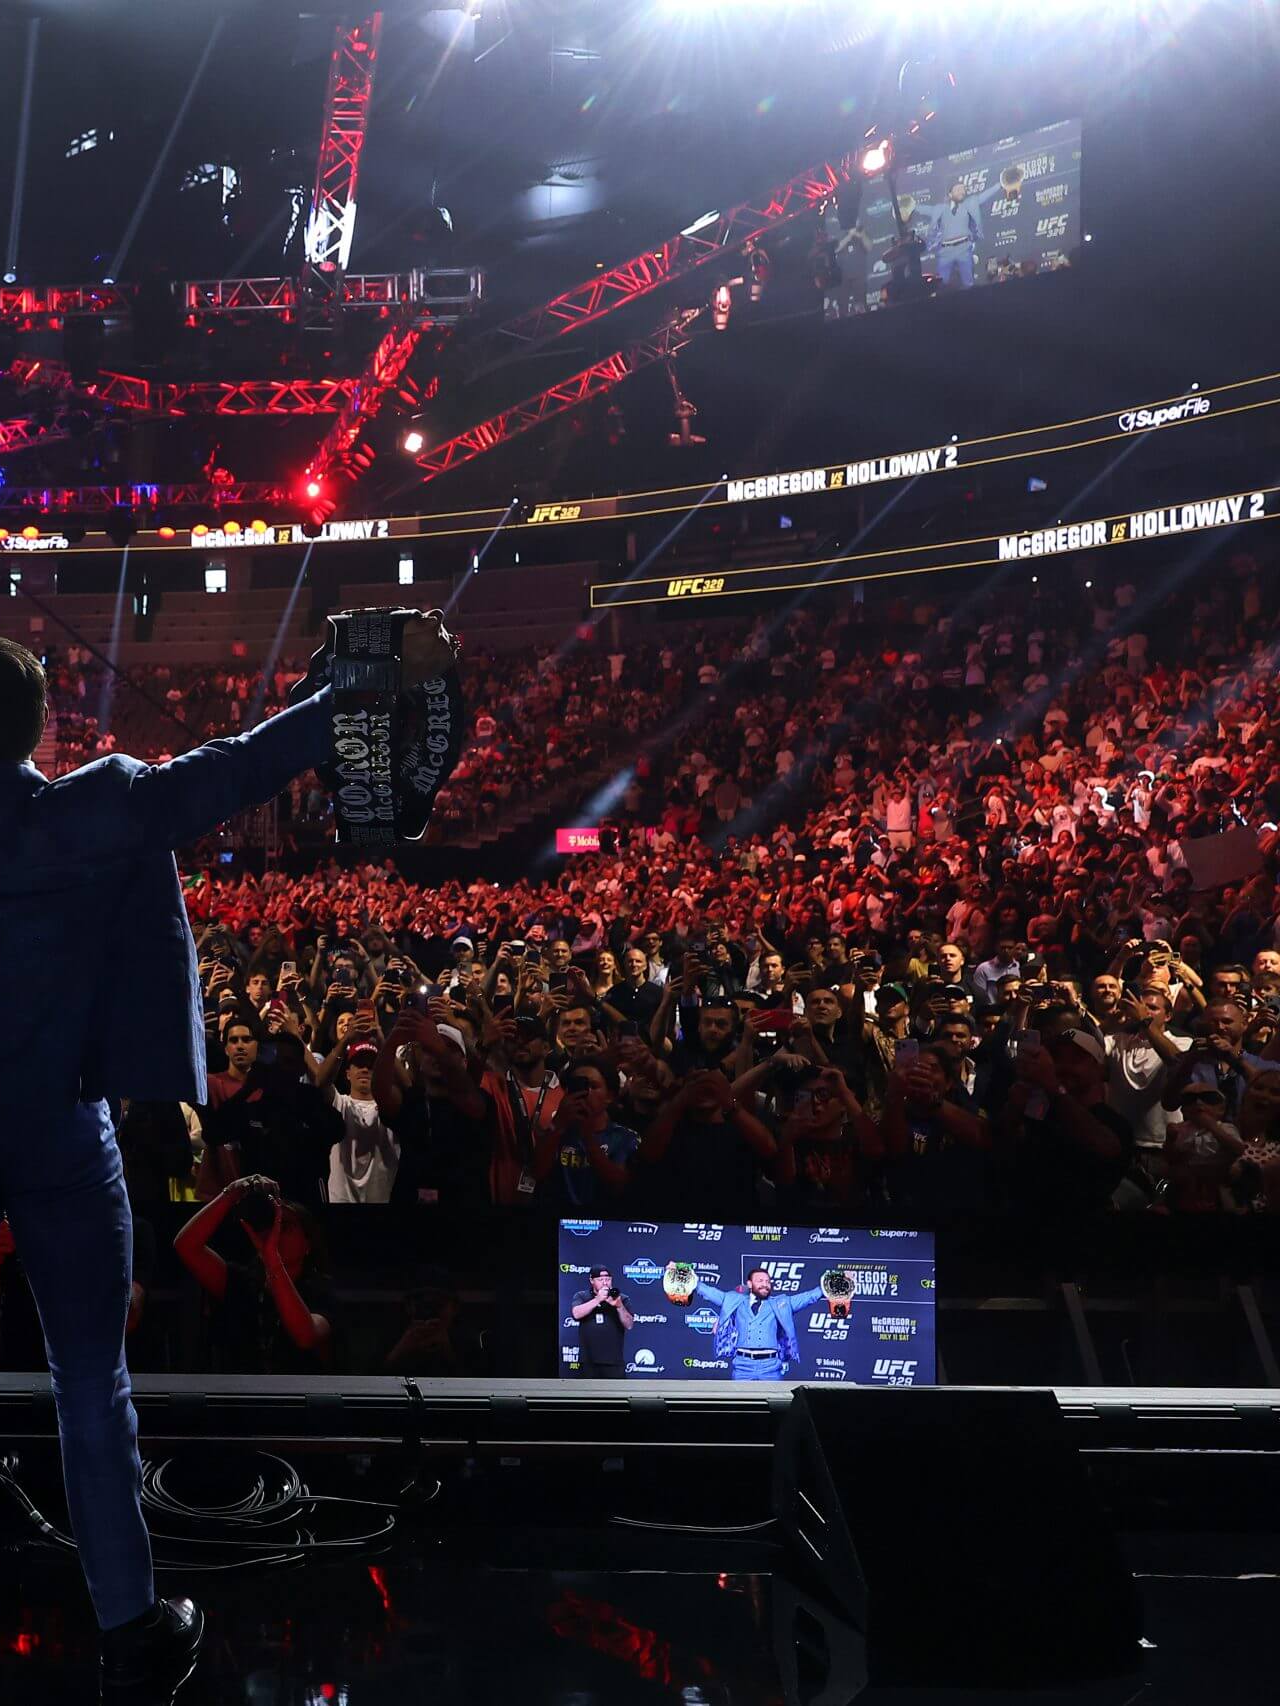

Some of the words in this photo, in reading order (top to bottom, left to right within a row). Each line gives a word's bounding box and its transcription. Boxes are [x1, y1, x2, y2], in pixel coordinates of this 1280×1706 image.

[1037, 214, 1068, 232] UFC
[1135, 397, 1210, 428] SuperFile
[727, 469, 826, 501] McGREGOR
[830, 471, 843, 488] VS
[846, 450, 941, 484] HOLLOWAY
[945, 446, 958, 468] 2
[377, 521, 388, 538] 2
[999, 521, 1107, 559] McGREGOR
[1111, 523, 1126, 542] VS
[1130, 497, 1244, 538] HOLLOWAY
[1249, 493, 1265, 519] 2
[667, 578, 703, 596] UFC
[409, 676, 451, 795] McGREG
[332, 709, 375, 823] CONOR
[370, 712, 394, 822] McGREGOR
[698, 1230, 722, 1240] 329
[745, 1225, 781, 1234] HOLLOWAY
[782, 1227, 787, 1235] 2
[760, 1262, 805, 1280] UFC
[773, 1280, 800, 1291] 329
[855, 1283, 887, 1295] OWAY
[890, 1284, 898, 1296] 2
[871, 1317, 910, 1326] McGREGOR
[872, 1326, 910, 1334] HOLLOWAY
[911, 1326, 916, 1334] 2
[823, 1330, 848, 1340] 329
[693, 1360, 728, 1369] SuperFile
[873, 1359, 918, 1376] UFC
